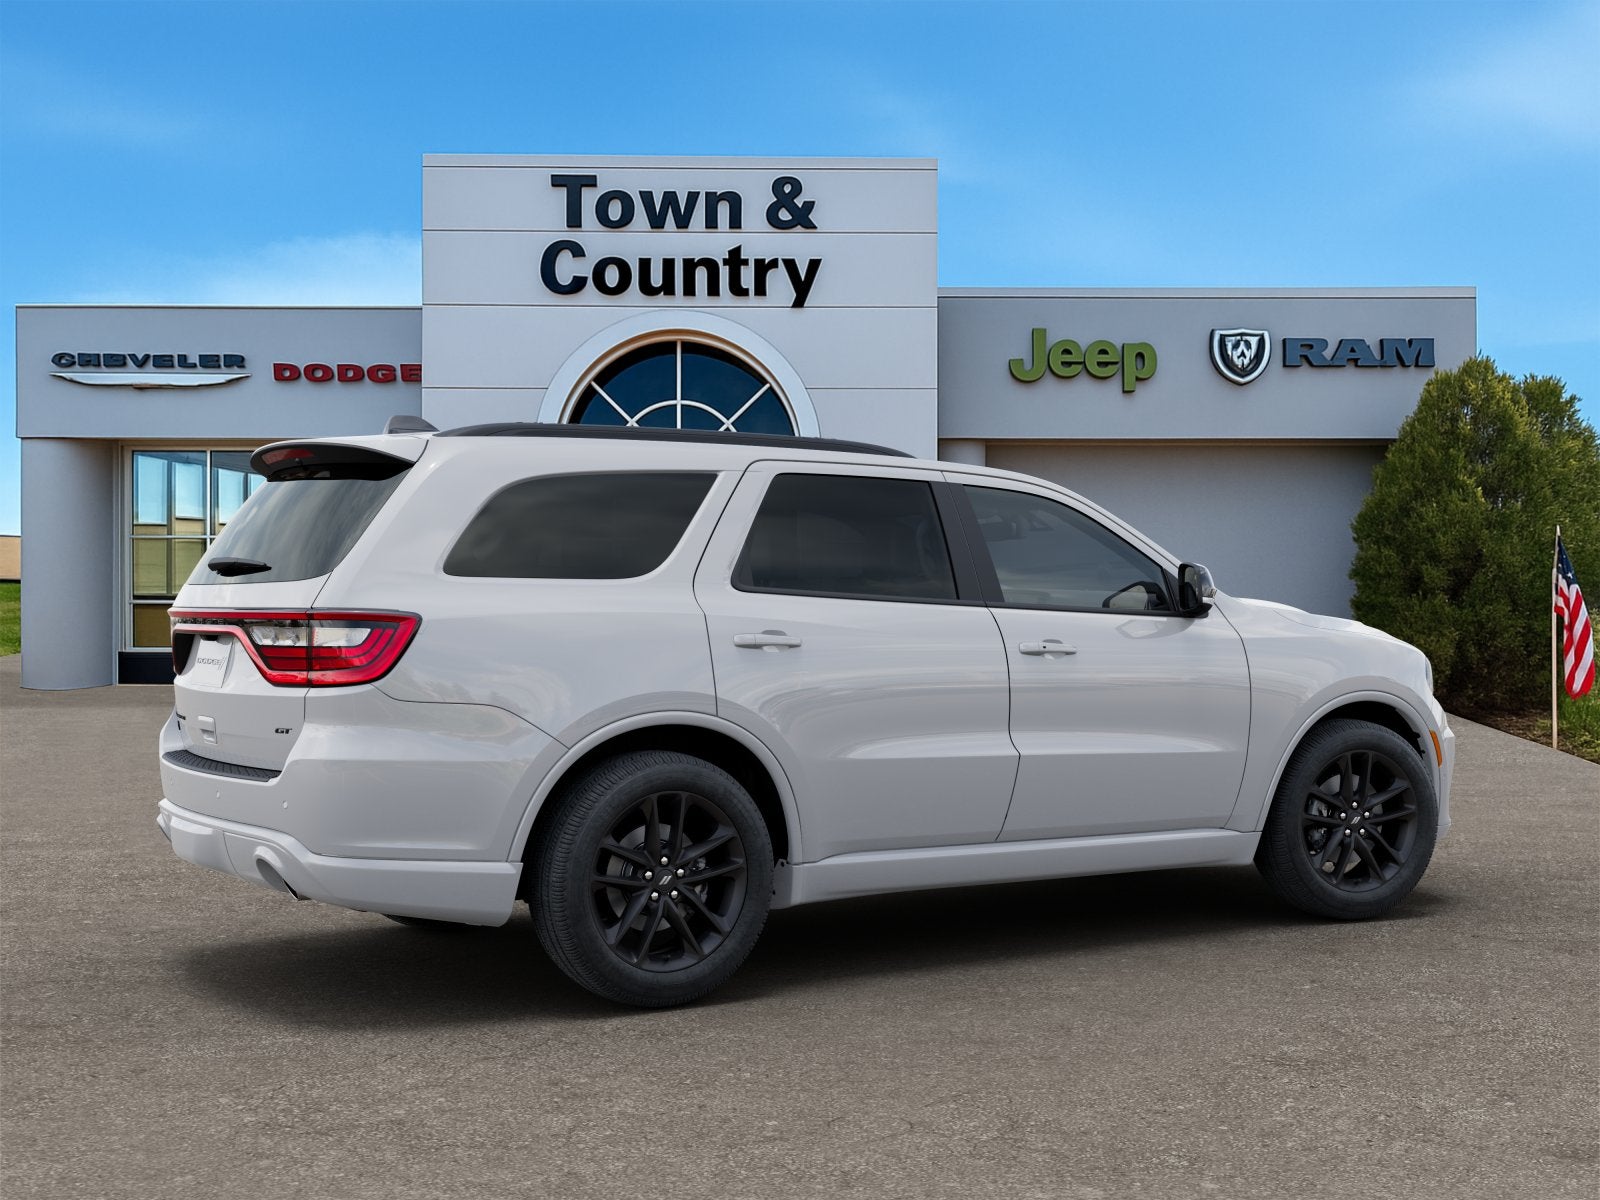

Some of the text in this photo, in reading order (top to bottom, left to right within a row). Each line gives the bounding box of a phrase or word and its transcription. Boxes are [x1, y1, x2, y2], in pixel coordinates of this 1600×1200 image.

[550, 174, 818, 231] Town &
[540, 239, 822, 308] Country
[273, 363, 422, 383] DODGE
[1008, 327, 1158, 393] Jeep
[1282, 337, 1436, 368] RAM
[274, 727, 293, 735] GT
